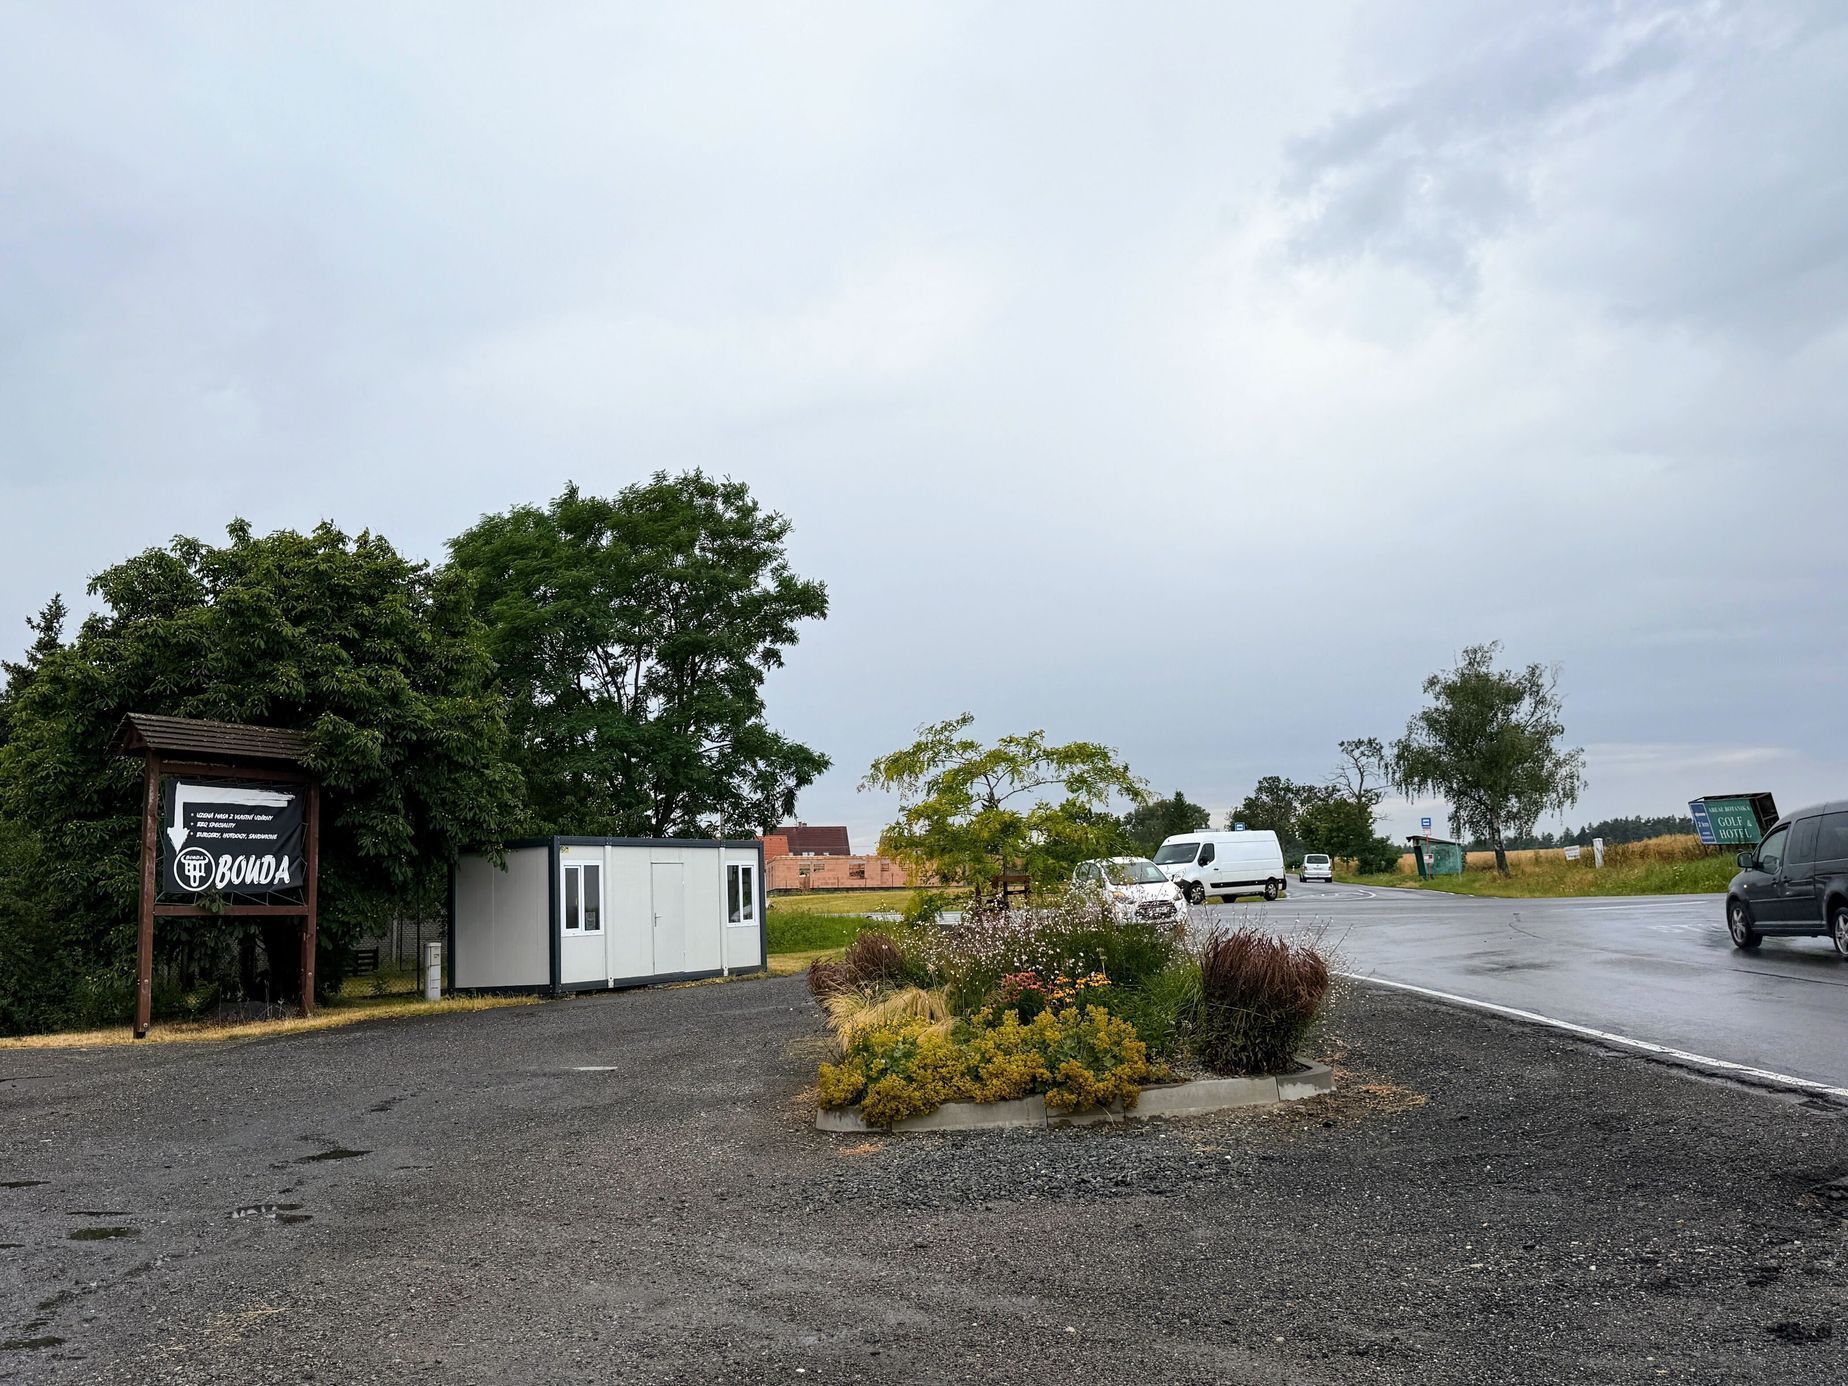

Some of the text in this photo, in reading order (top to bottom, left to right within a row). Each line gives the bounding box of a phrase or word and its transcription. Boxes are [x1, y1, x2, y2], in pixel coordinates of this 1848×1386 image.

[1718, 816, 1752, 827] GOLF &
[1719, 828, 1752, 839] HOTEL
[215, 854, 290, 889] BOUDA
